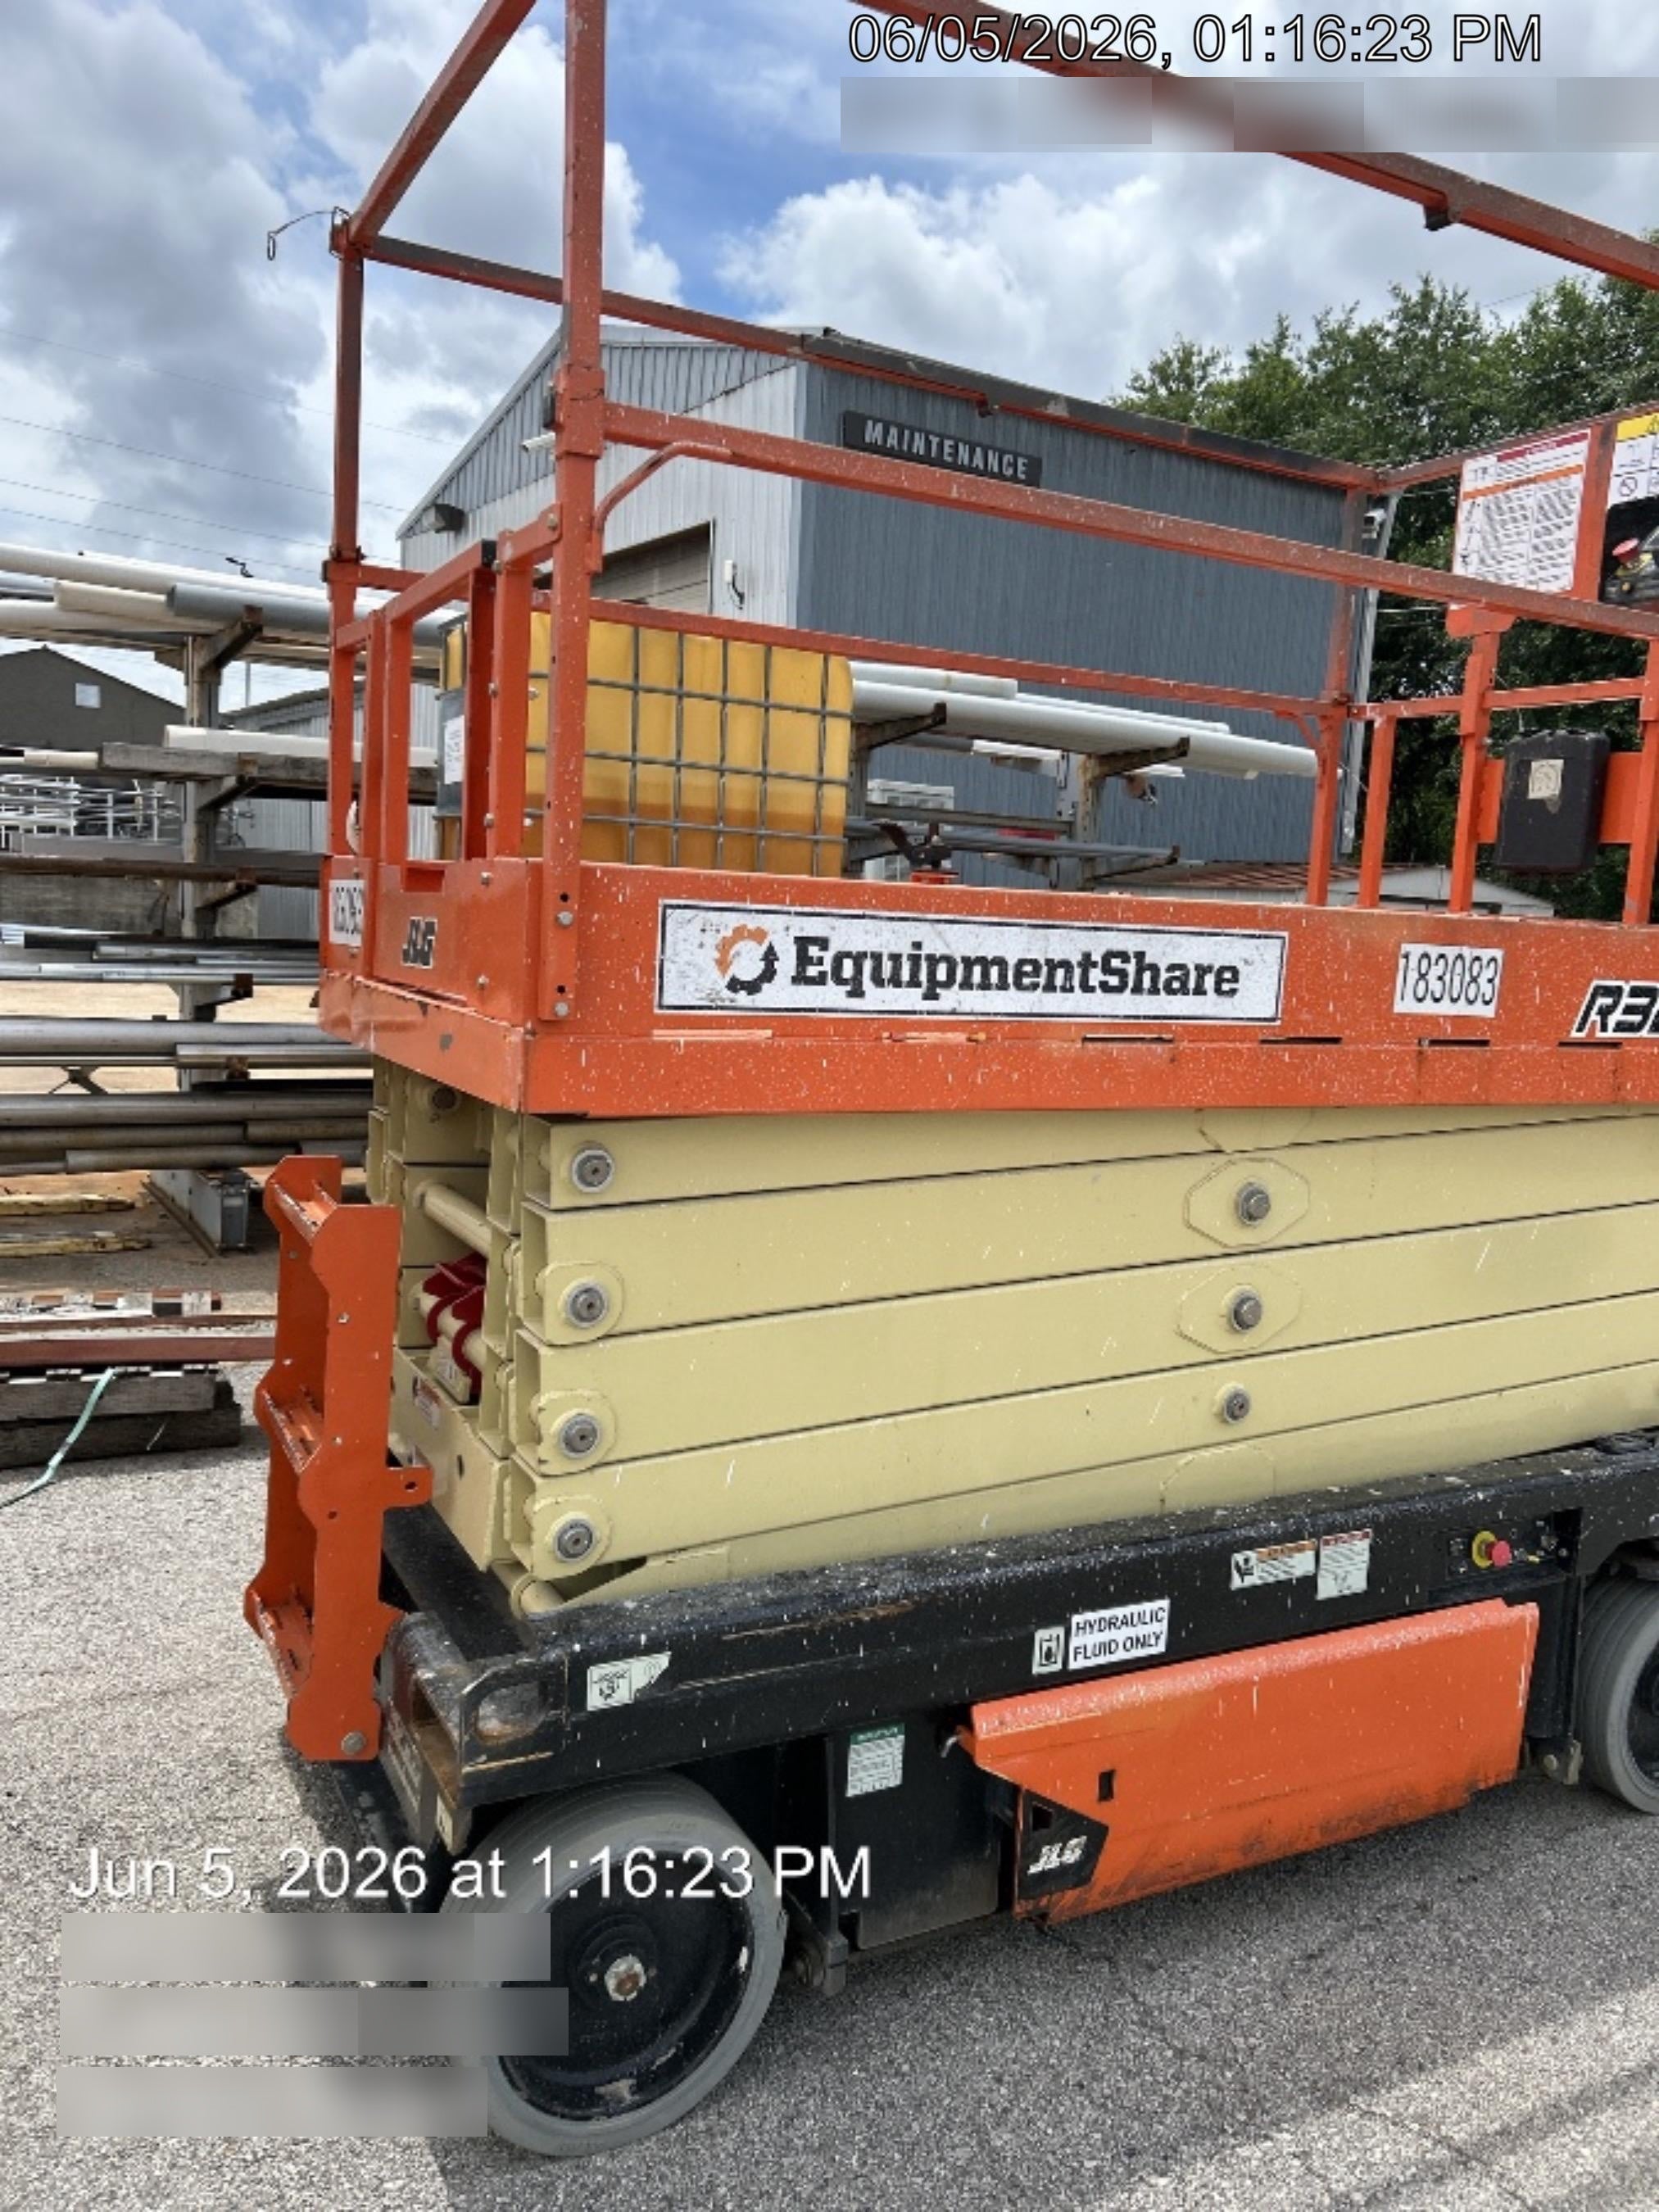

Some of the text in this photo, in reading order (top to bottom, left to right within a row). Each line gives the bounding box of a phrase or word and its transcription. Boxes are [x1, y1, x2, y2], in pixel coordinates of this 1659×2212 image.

[863, 419, 1029, 480] MAINTENANCE
[791, 935, 1241, 1001] EquipmentShare
[1399, 950, 1499, 1006] 183083
[1073, 1630, 1164, 1663] FLUID ONLY
[1074, 1607, 1167, 1638] HYDRAULIC
